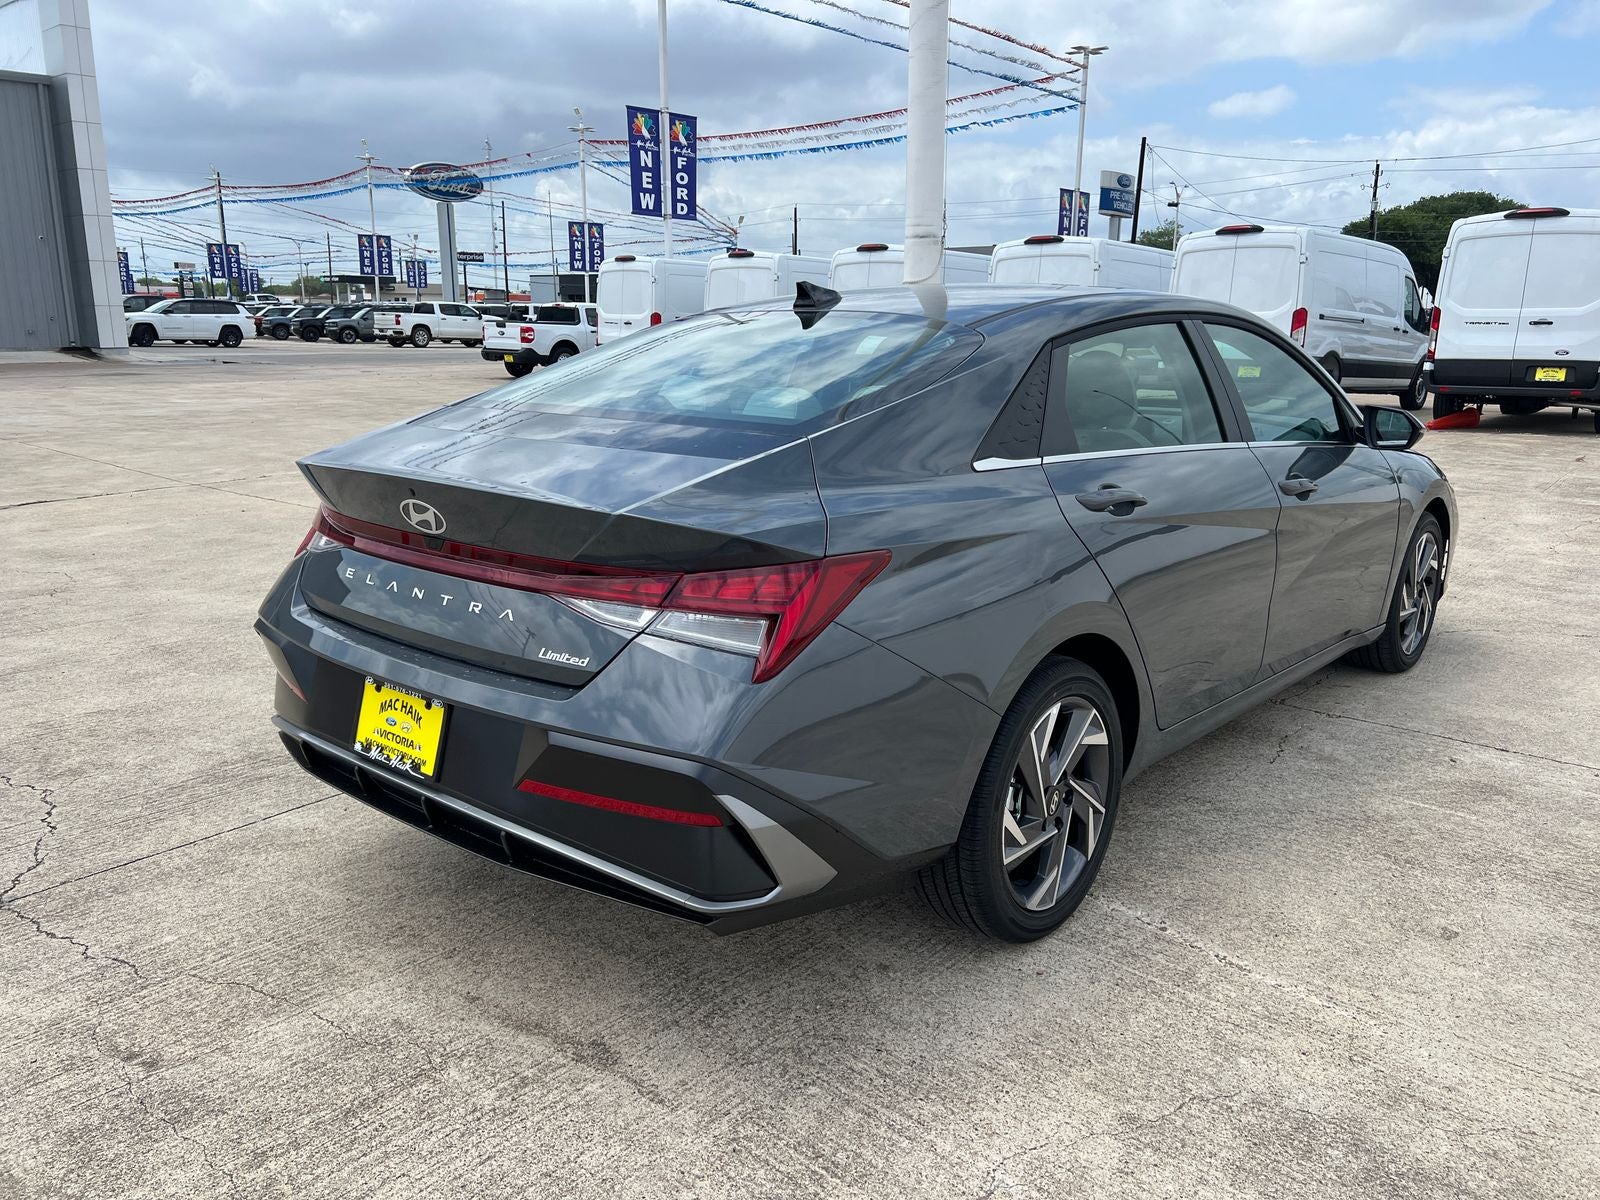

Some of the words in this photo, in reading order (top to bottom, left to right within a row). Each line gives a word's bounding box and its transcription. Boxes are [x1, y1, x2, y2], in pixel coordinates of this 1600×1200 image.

[639, 150, 655, 210] NEW
[676, 156, 689, 215] FORD
[1110, 190, 1134, 203] PRE-OWNE
[1078, 219, 1086, 237] FO
[213, 256, 222, 277] NEW
[363, 250, 372, 274] NEW
[381, 251, 389, 275] FORD
[457, 253, 483, 261] terprise
[573, 241, 583, 269] NEW
[593, 242, 601, 271] FORD
[345, 567, 514, 622] ELANTRA
[538, 647, 590, 667] Limited
[379, 698, 399, 715] MAC
[400, 700, 423, 730] HAIK
[379, 728, 414, 750] VICTORIA
